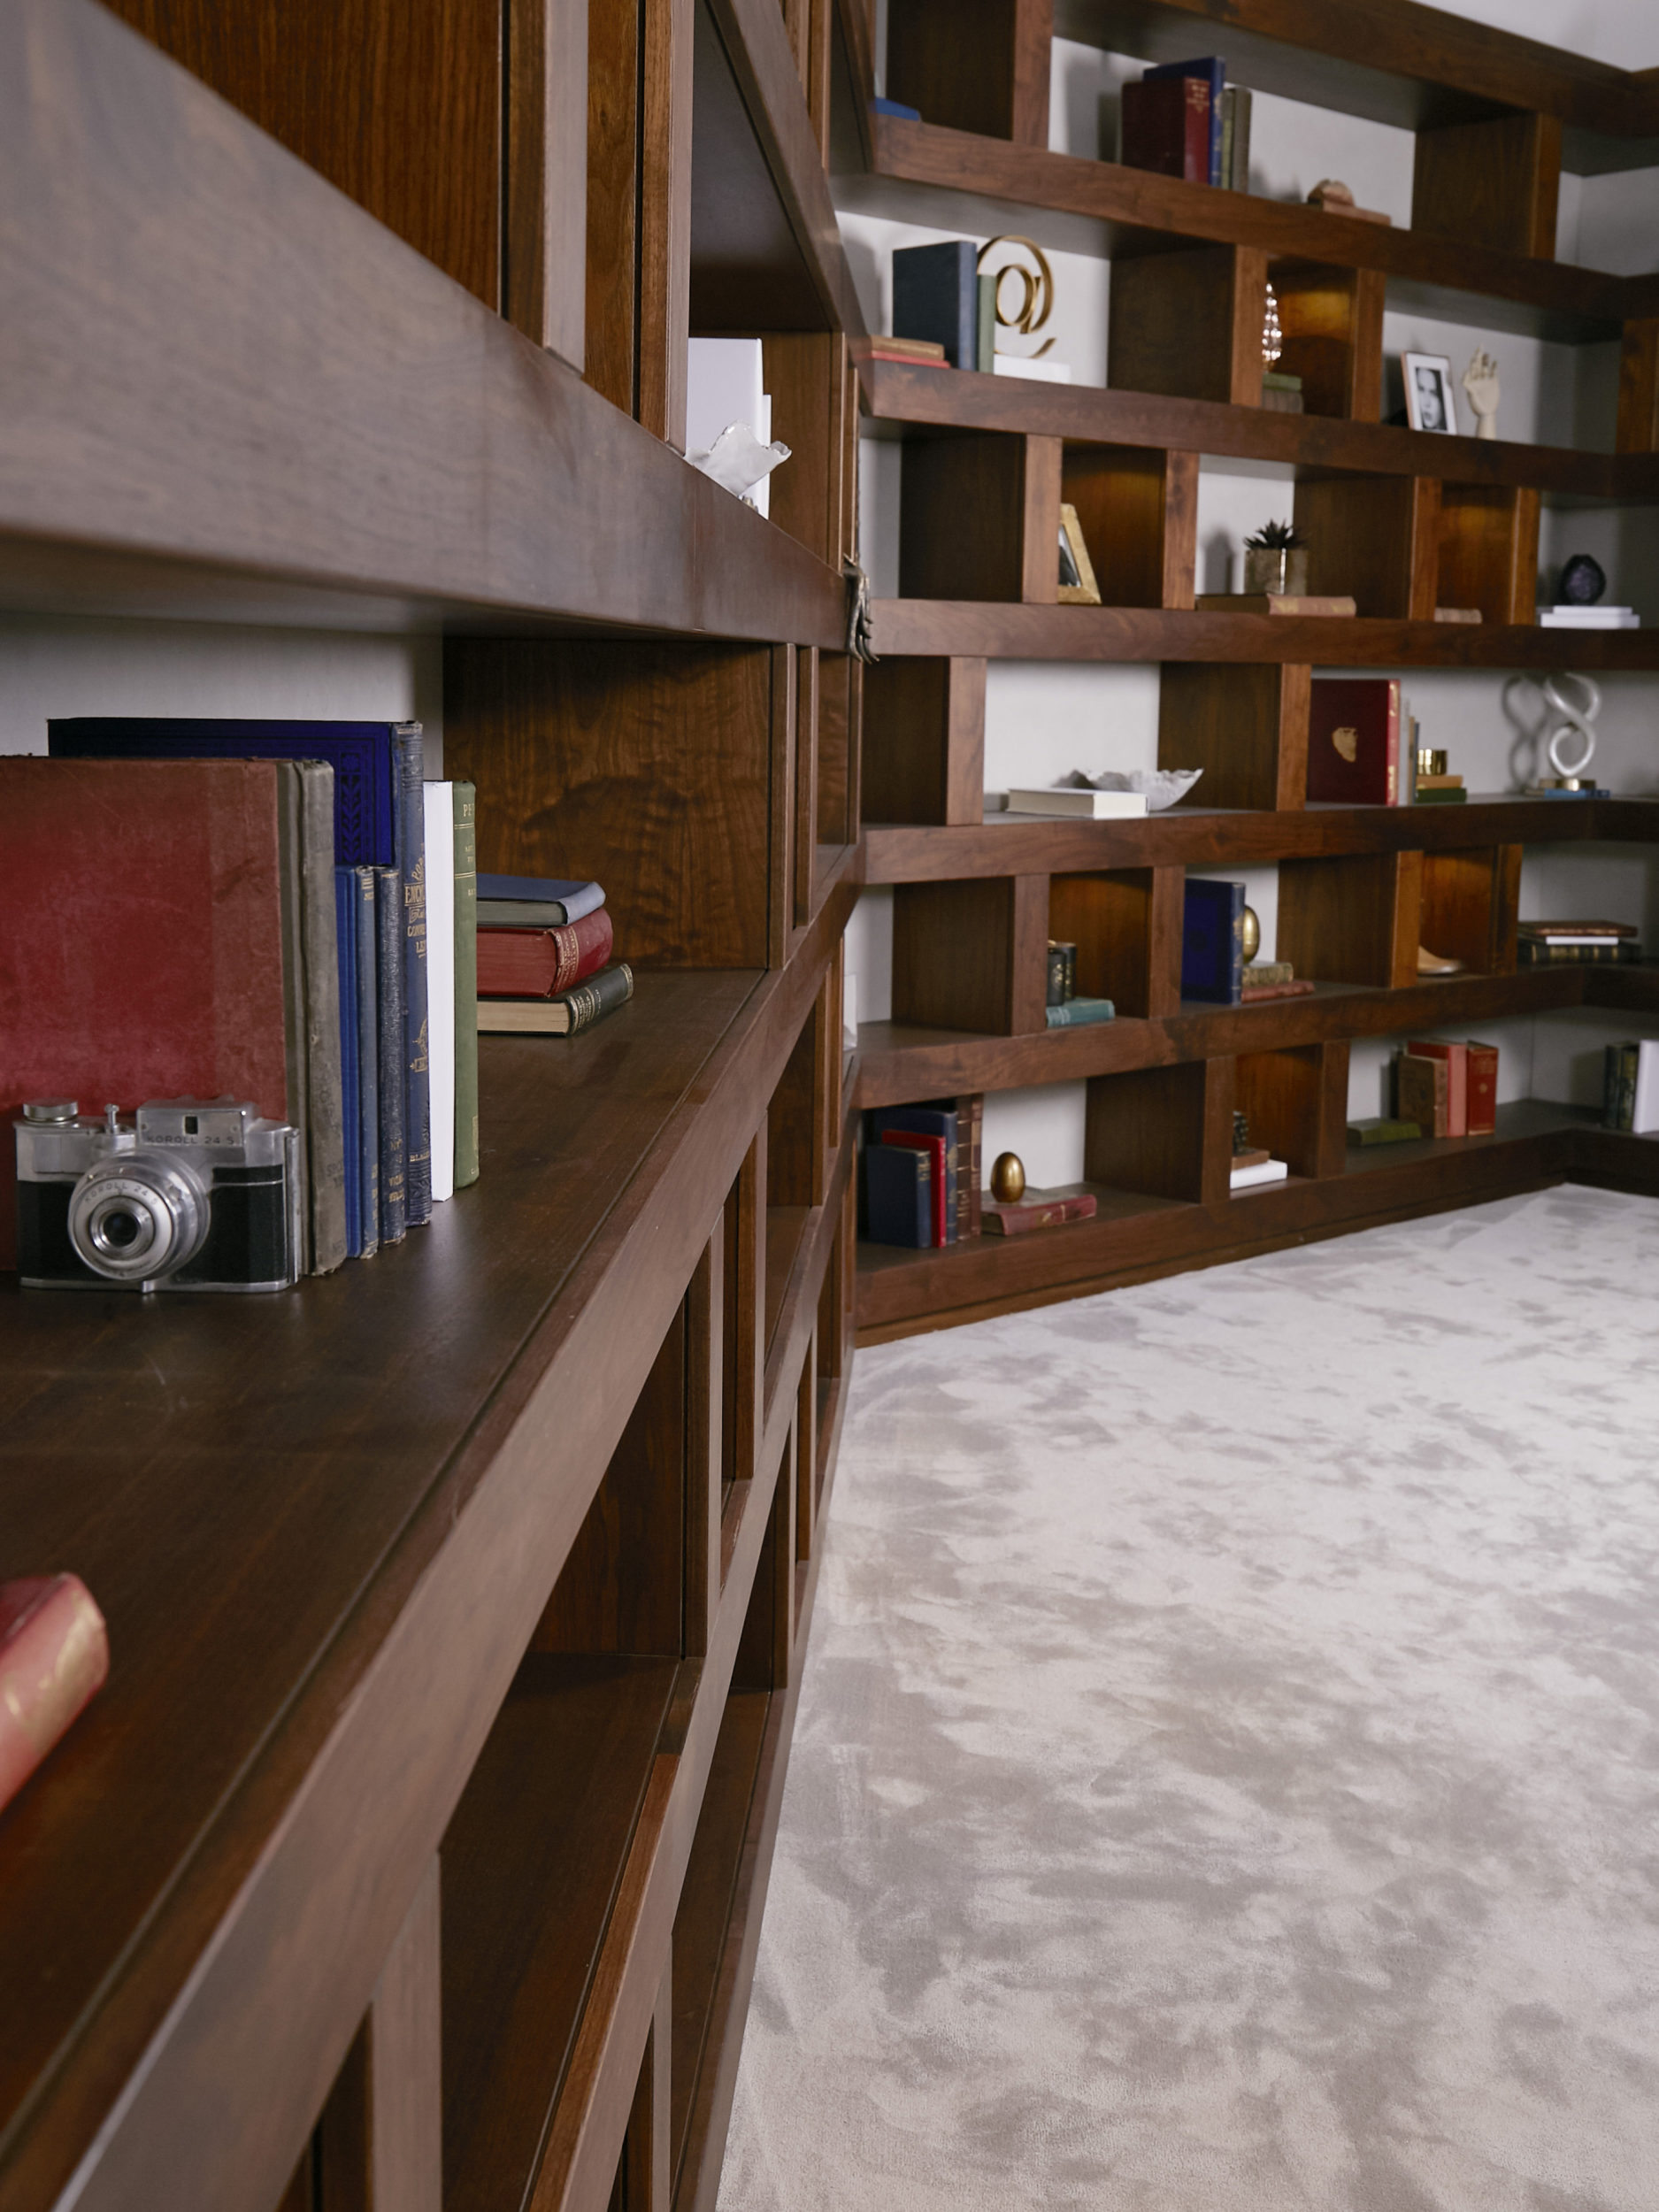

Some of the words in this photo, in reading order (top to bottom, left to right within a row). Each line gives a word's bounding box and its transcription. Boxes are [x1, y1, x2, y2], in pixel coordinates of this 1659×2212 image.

[147, 1135, 198, 1145] KOROLL
[204, 1136, 220, 1145] 24
[226, 1136, 235, 1146] S
